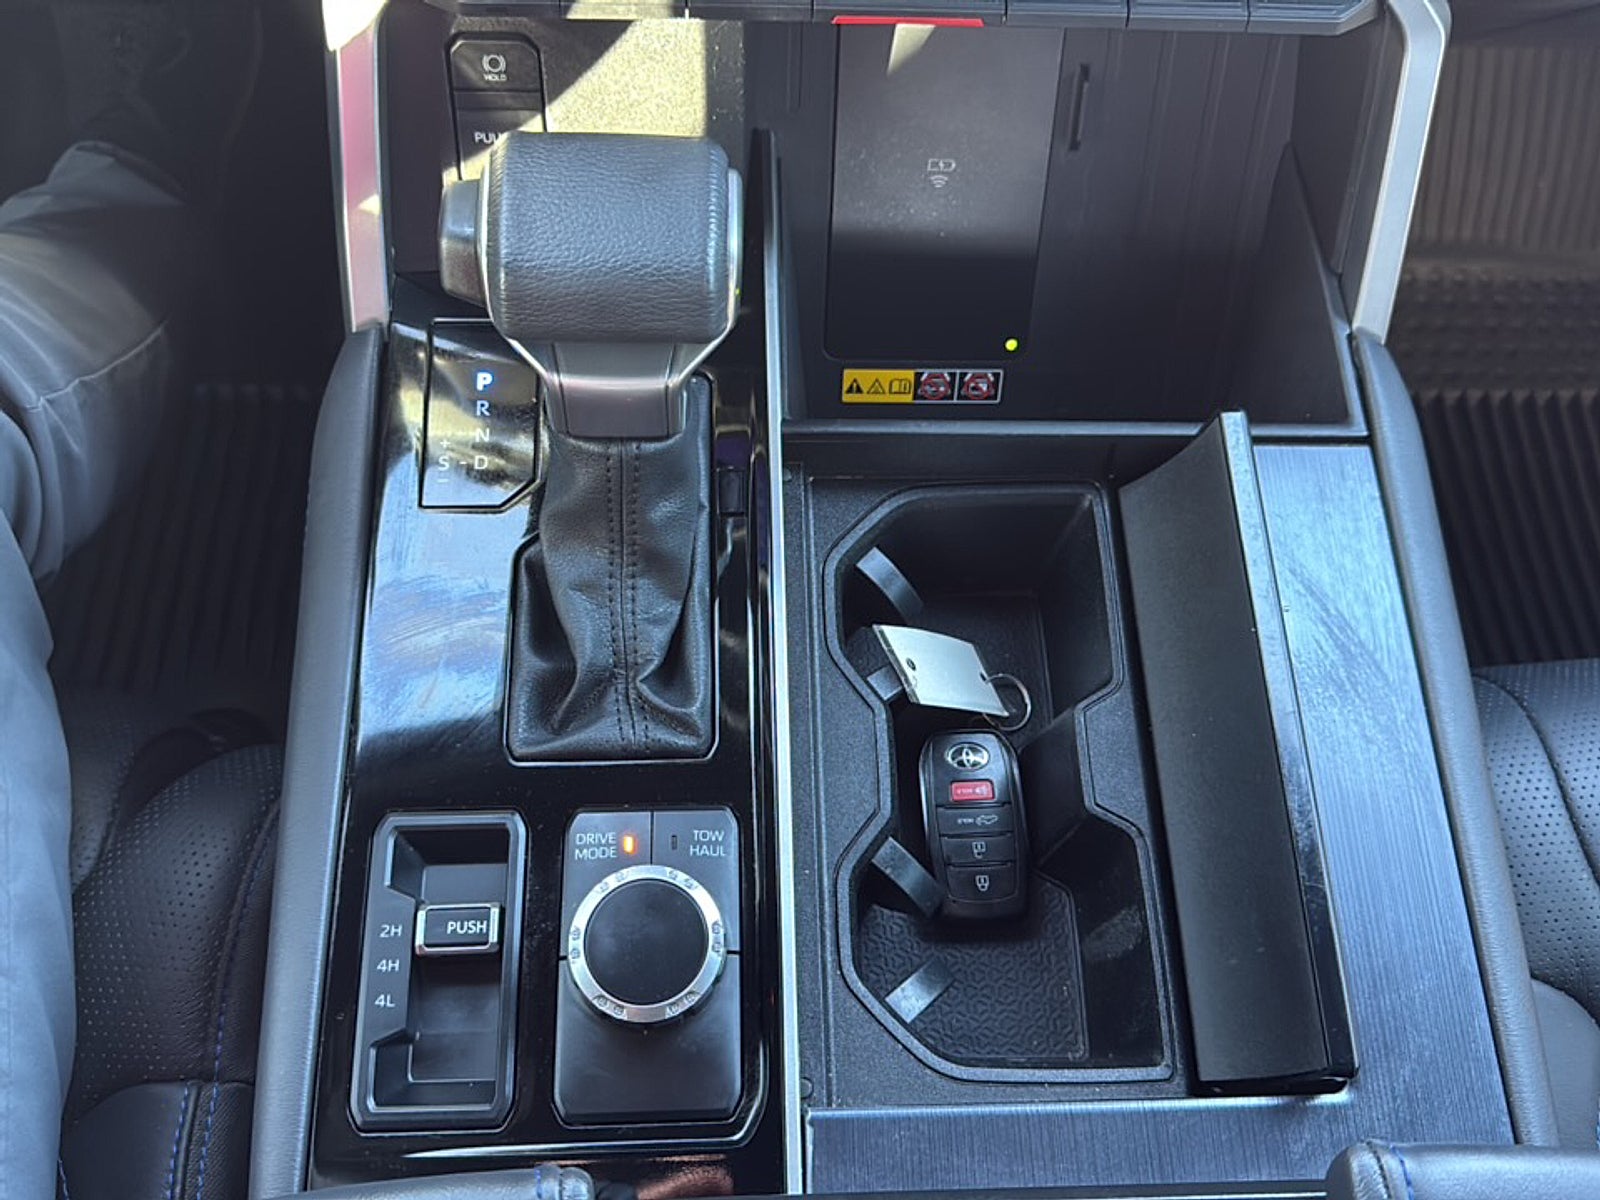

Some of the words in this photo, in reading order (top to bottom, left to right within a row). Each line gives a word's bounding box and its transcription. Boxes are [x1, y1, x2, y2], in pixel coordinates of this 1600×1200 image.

[476, 371, 493, 391] P
[476, 400, 491, 416] R
[475, 427, 490, 443] N
[438, 456, 450, 471] S
[474, 455, 489, 470] D
[575, 832, 617, 845] DRIVE
[693, 830, 725, 842] TOW
[574, 847, 618, 860] MODE
[689, 845, 727, 857] HAUL
[379, 924, 402, 938] 2H
[446, 920, 488, 935] PUSH
[376, 959, 401, 973] 4H
[374, 994, 396, 1008] 4L
